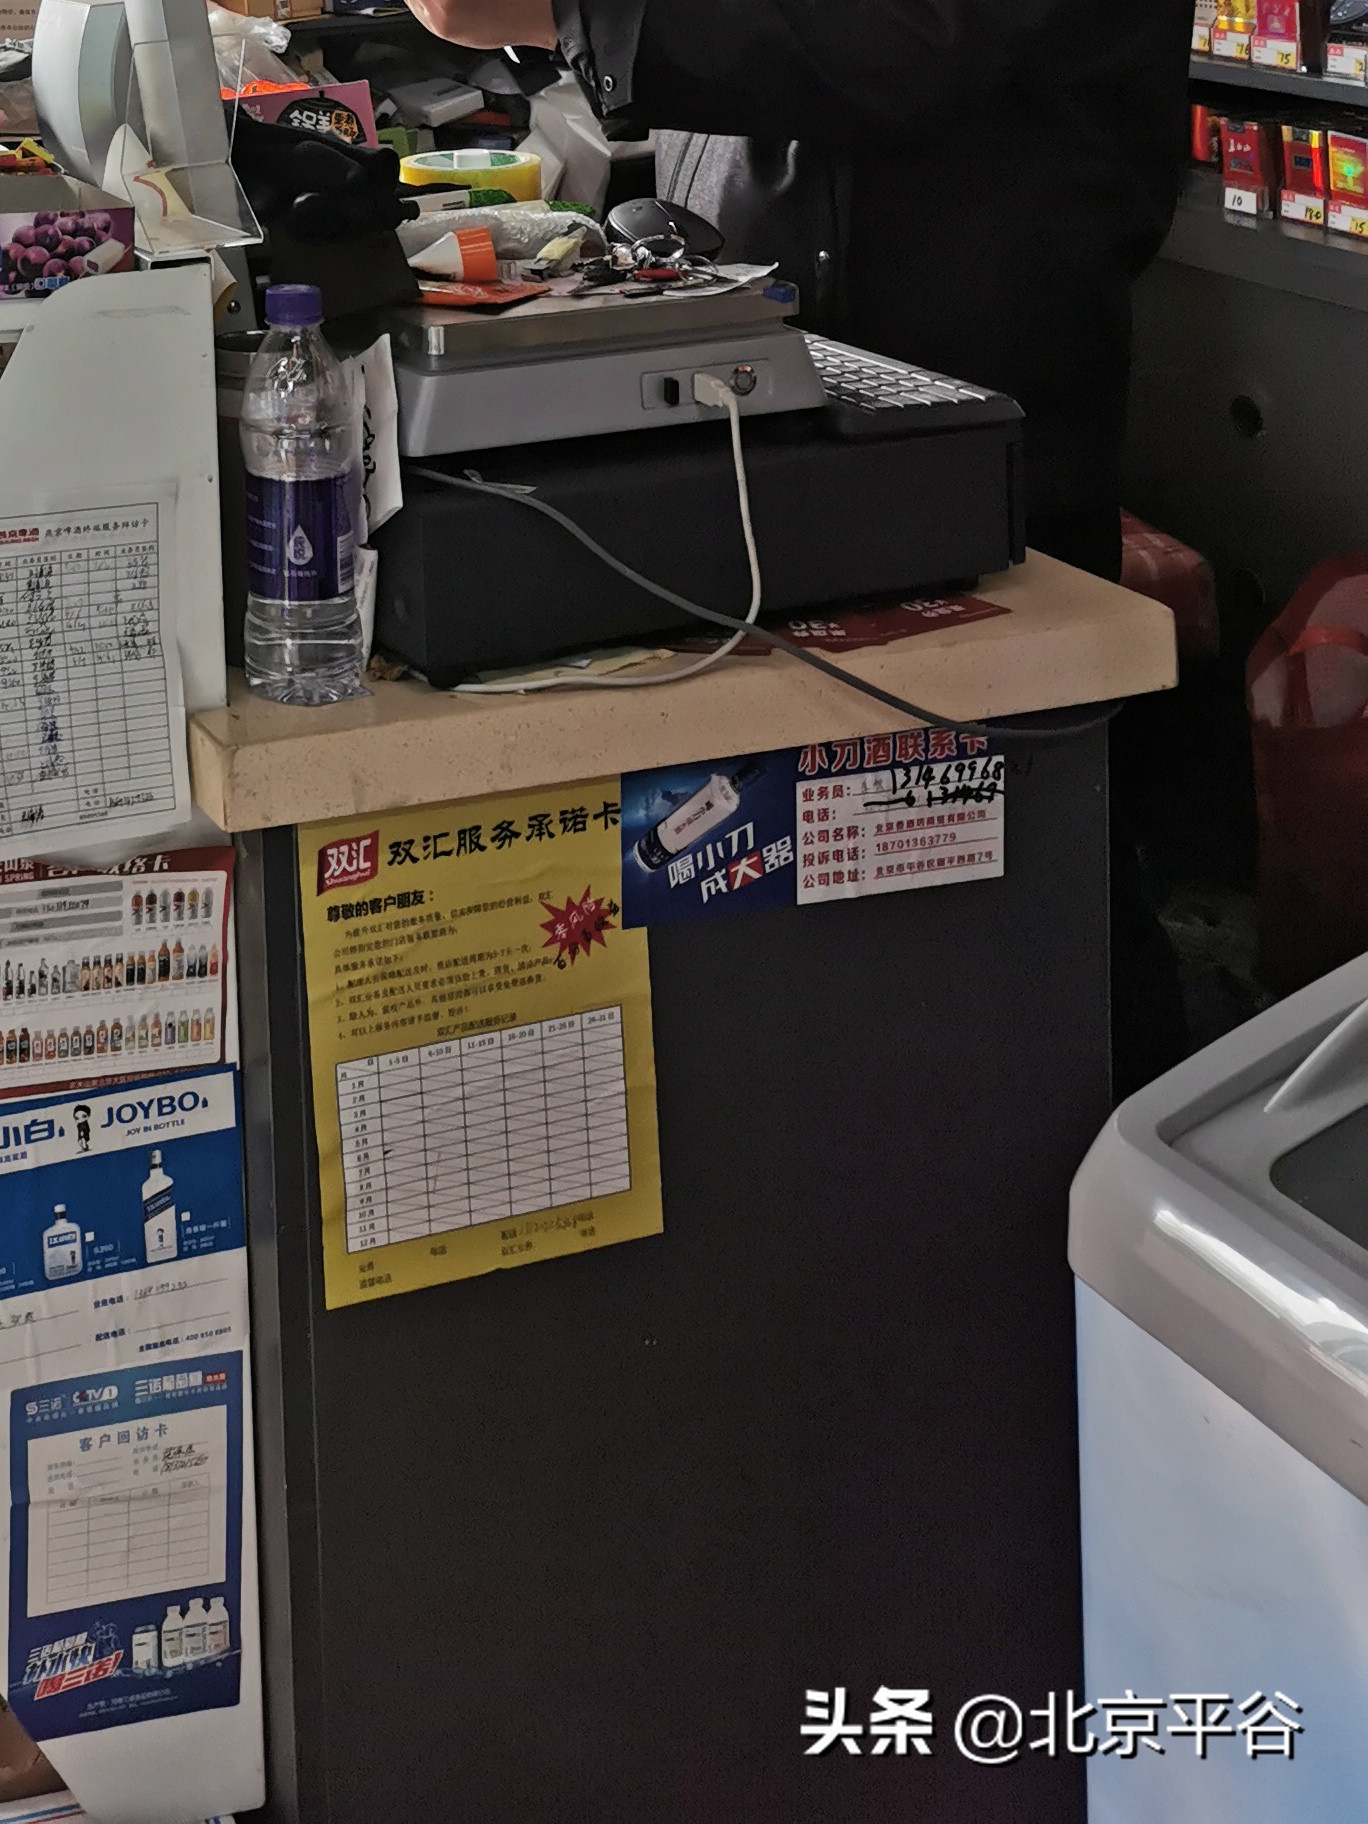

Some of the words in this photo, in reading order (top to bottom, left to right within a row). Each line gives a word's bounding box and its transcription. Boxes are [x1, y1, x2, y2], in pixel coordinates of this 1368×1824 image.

[802, 784, 851, 802] 业务员：
[802, 807, 836, 824] 电话：
[325, 836, 371, 878] 双汇
[386, 800, 622, 868] 双汇服务承诺卡
[802, 824, 866, 845] 公司名称：
[666, 821, 755, 889] 喝小刀
[802, 846, 866, 868] 投诉电话：
[700, 835, 794, 904] 成大器
[802, 868, 866, 889] 公司地址：
[326, 889, 435, 923] 尊敬的客户朋友：
[100, 1090, 200, 1129] JOYBO
[126, 1126, 141, 1137] JOY
[154, 1118, 185, 1132] BOTTLE
[79, 1423, 168, 1452] 客户回访卡
